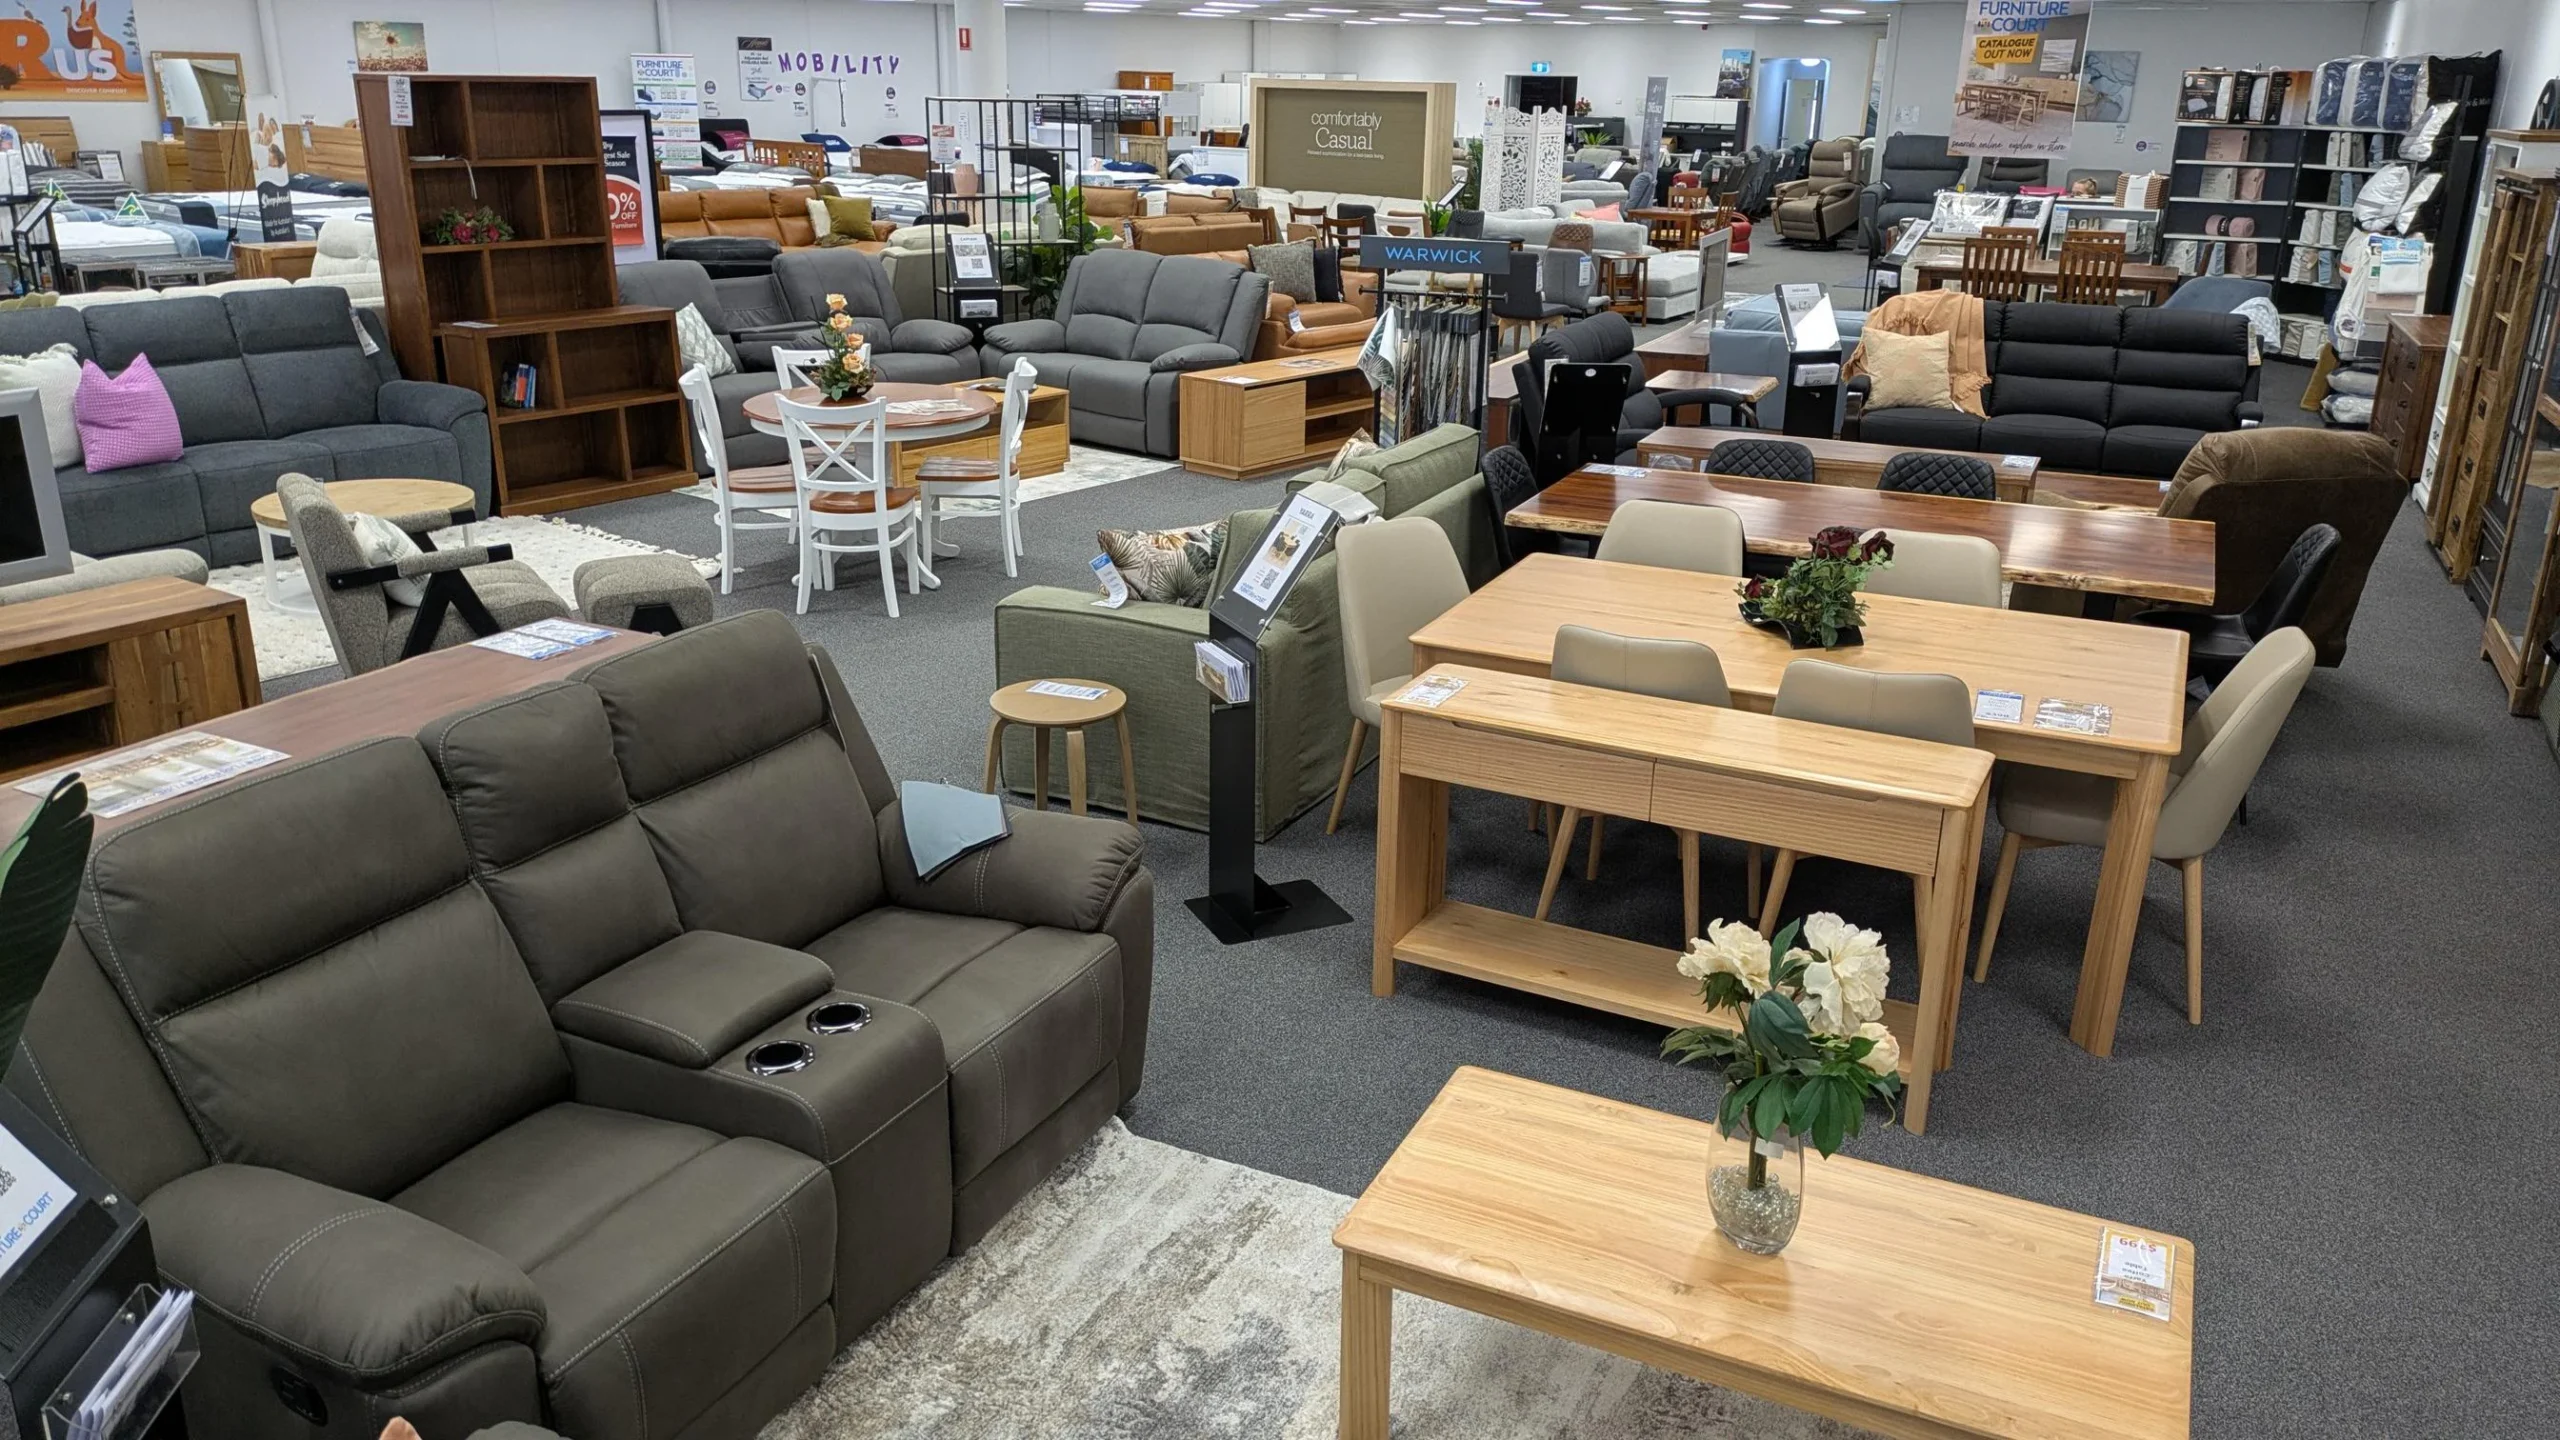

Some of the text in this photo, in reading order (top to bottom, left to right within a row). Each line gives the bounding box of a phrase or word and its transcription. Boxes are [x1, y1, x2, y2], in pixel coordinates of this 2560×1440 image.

[1979, 1, 2070, 16] FURNITURE
[1991, 17, 2050, 32] COURT
[1979, 38, 2036, 48] CATALOGUE
[1984, 48, 2033, 59] OUT NOW
[53, 48, 118, 81] US
[636, 60, 683, 69] FURNITURE
[777, 52, 900, 76] MOBILITY
[645, 69, 675, 77] COURT
[1311, 110, 1383, 131] comfortably
[1315, 127, 1374, 151] Casual
[616, 151, 632, 159] Sale
[604, 159, 626, 167] Season
[621, 211, 638, 220] OFF
[1385, 246, 1482, 265] WARWICK
[23, 1191, 54, 1225] COURT
